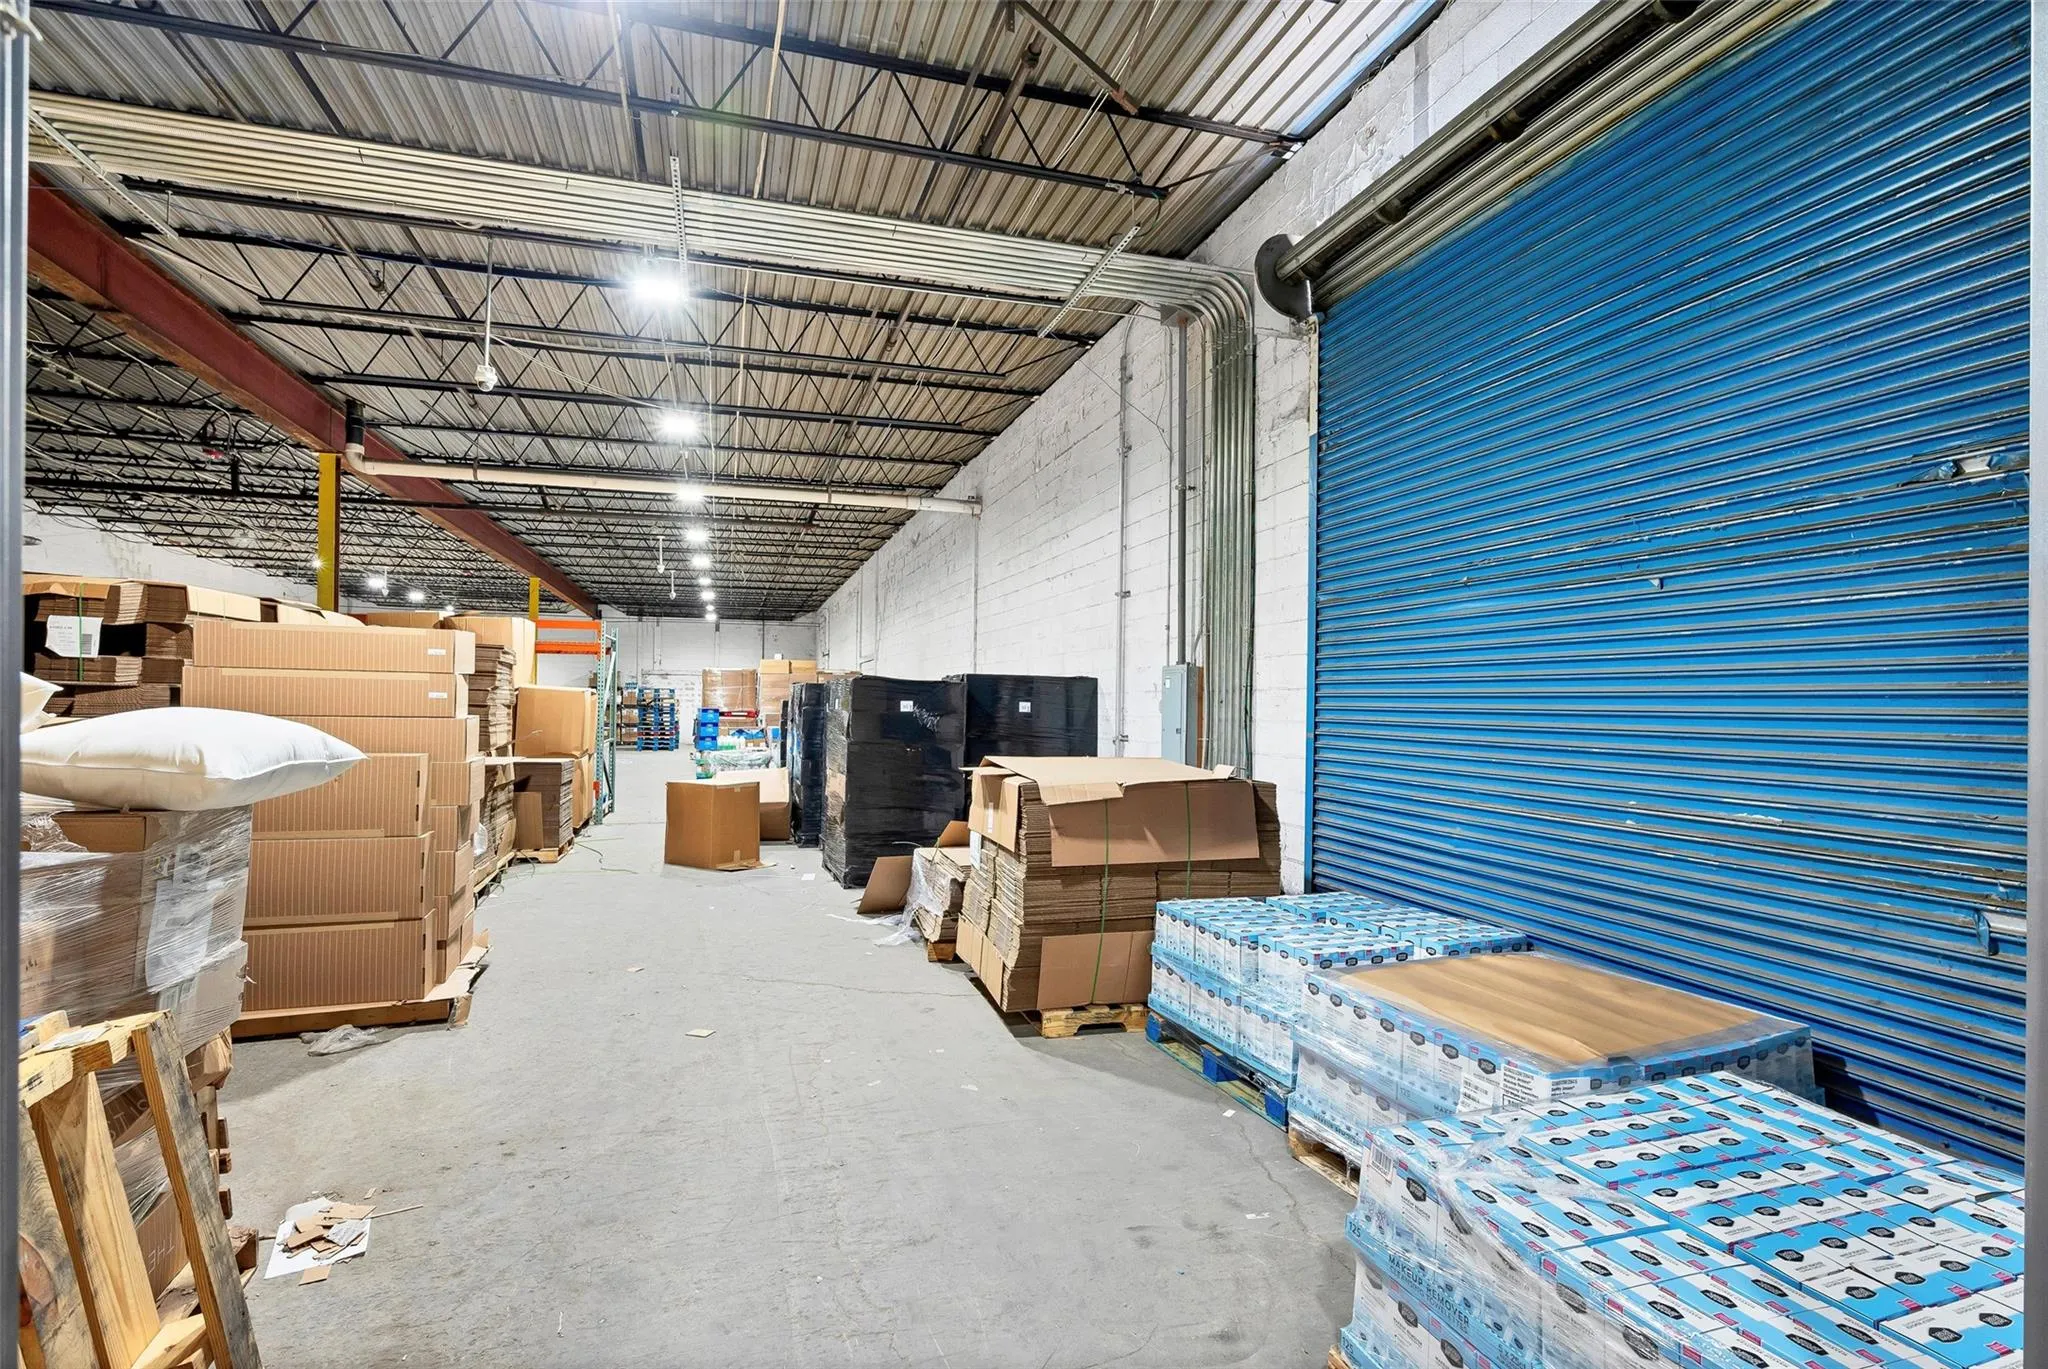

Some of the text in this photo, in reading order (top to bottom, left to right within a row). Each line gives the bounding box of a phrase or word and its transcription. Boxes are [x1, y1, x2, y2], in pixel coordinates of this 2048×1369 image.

[1348, 1221, 1361, 1238] 125
[1388, 1254, 1423, 1285] MAKEUP
[1426, 1285, 1469, 1326] REMOVER
